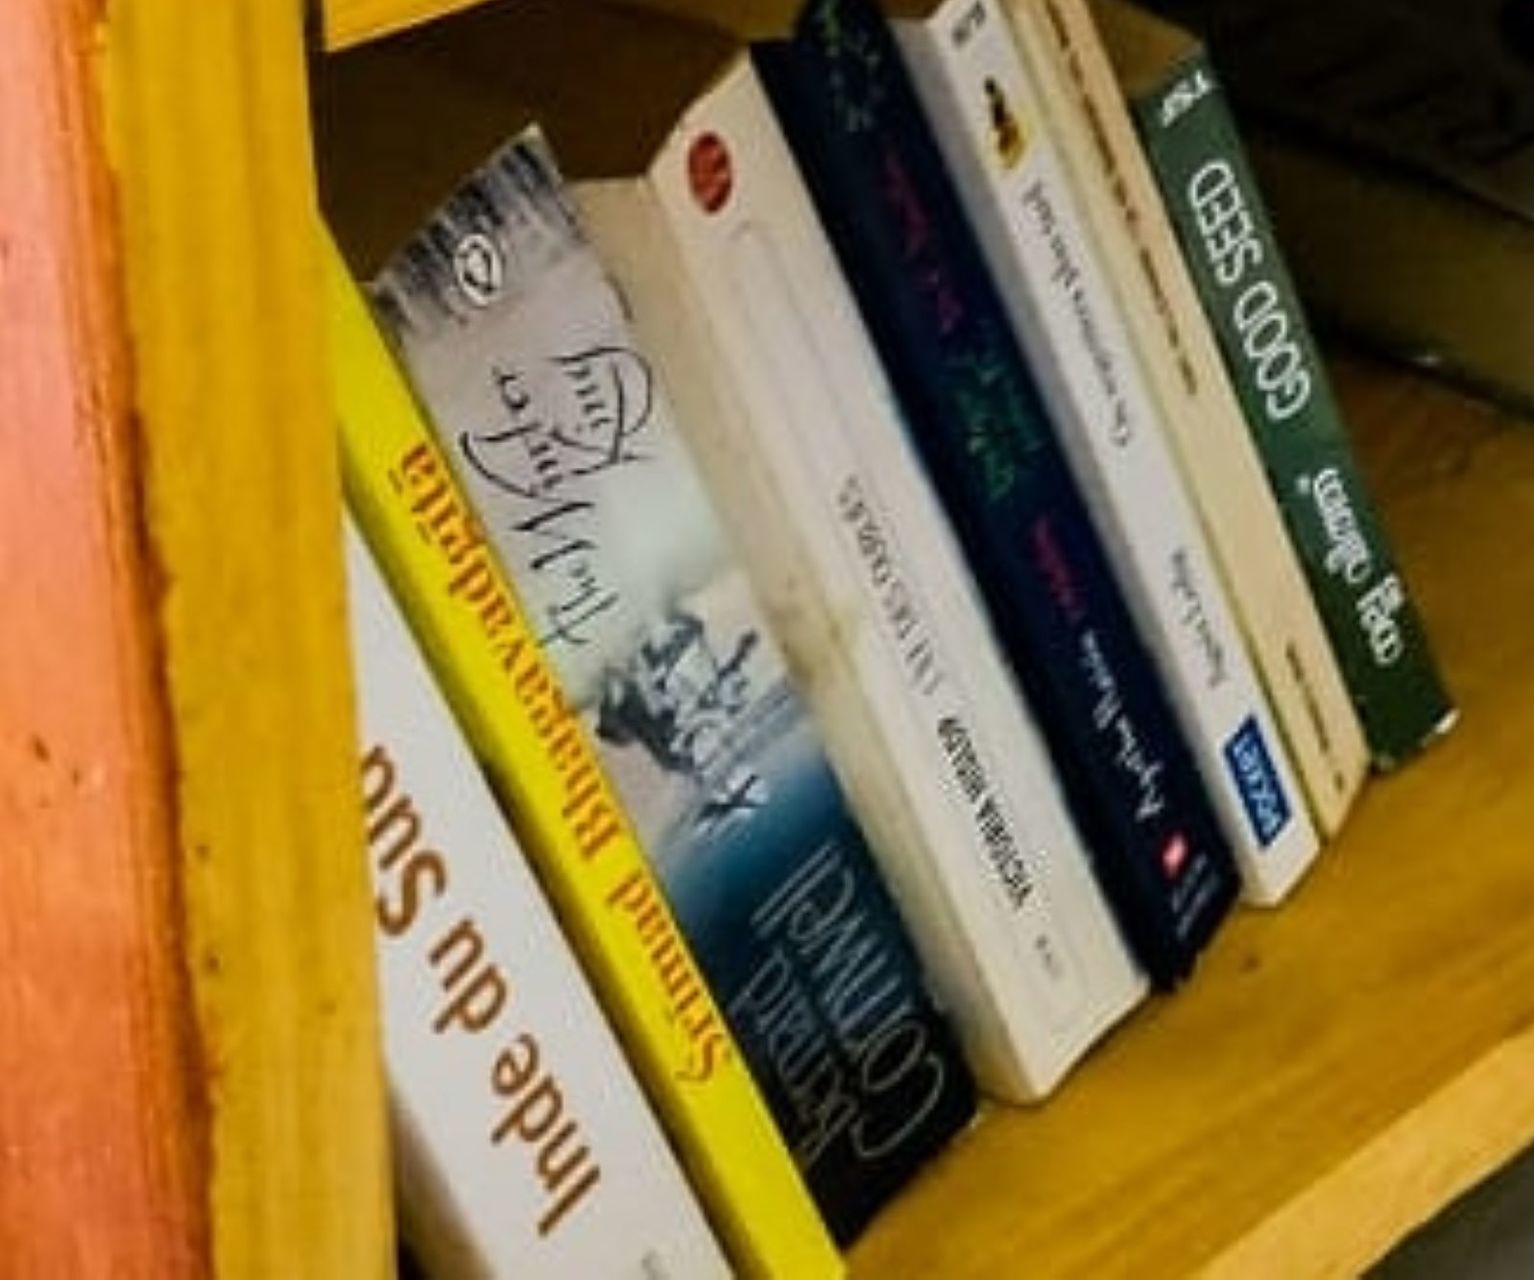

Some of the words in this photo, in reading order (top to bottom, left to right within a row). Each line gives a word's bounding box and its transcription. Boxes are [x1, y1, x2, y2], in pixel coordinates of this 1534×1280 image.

[1186, 158, 1263, 285] SEED
[1233, 280, 1311, 420] GOOD
[430, 919, 508, 1034] du
[751, 840, 945, 1160] Cornwell
[490, 1032, 601, 1237] Inde
